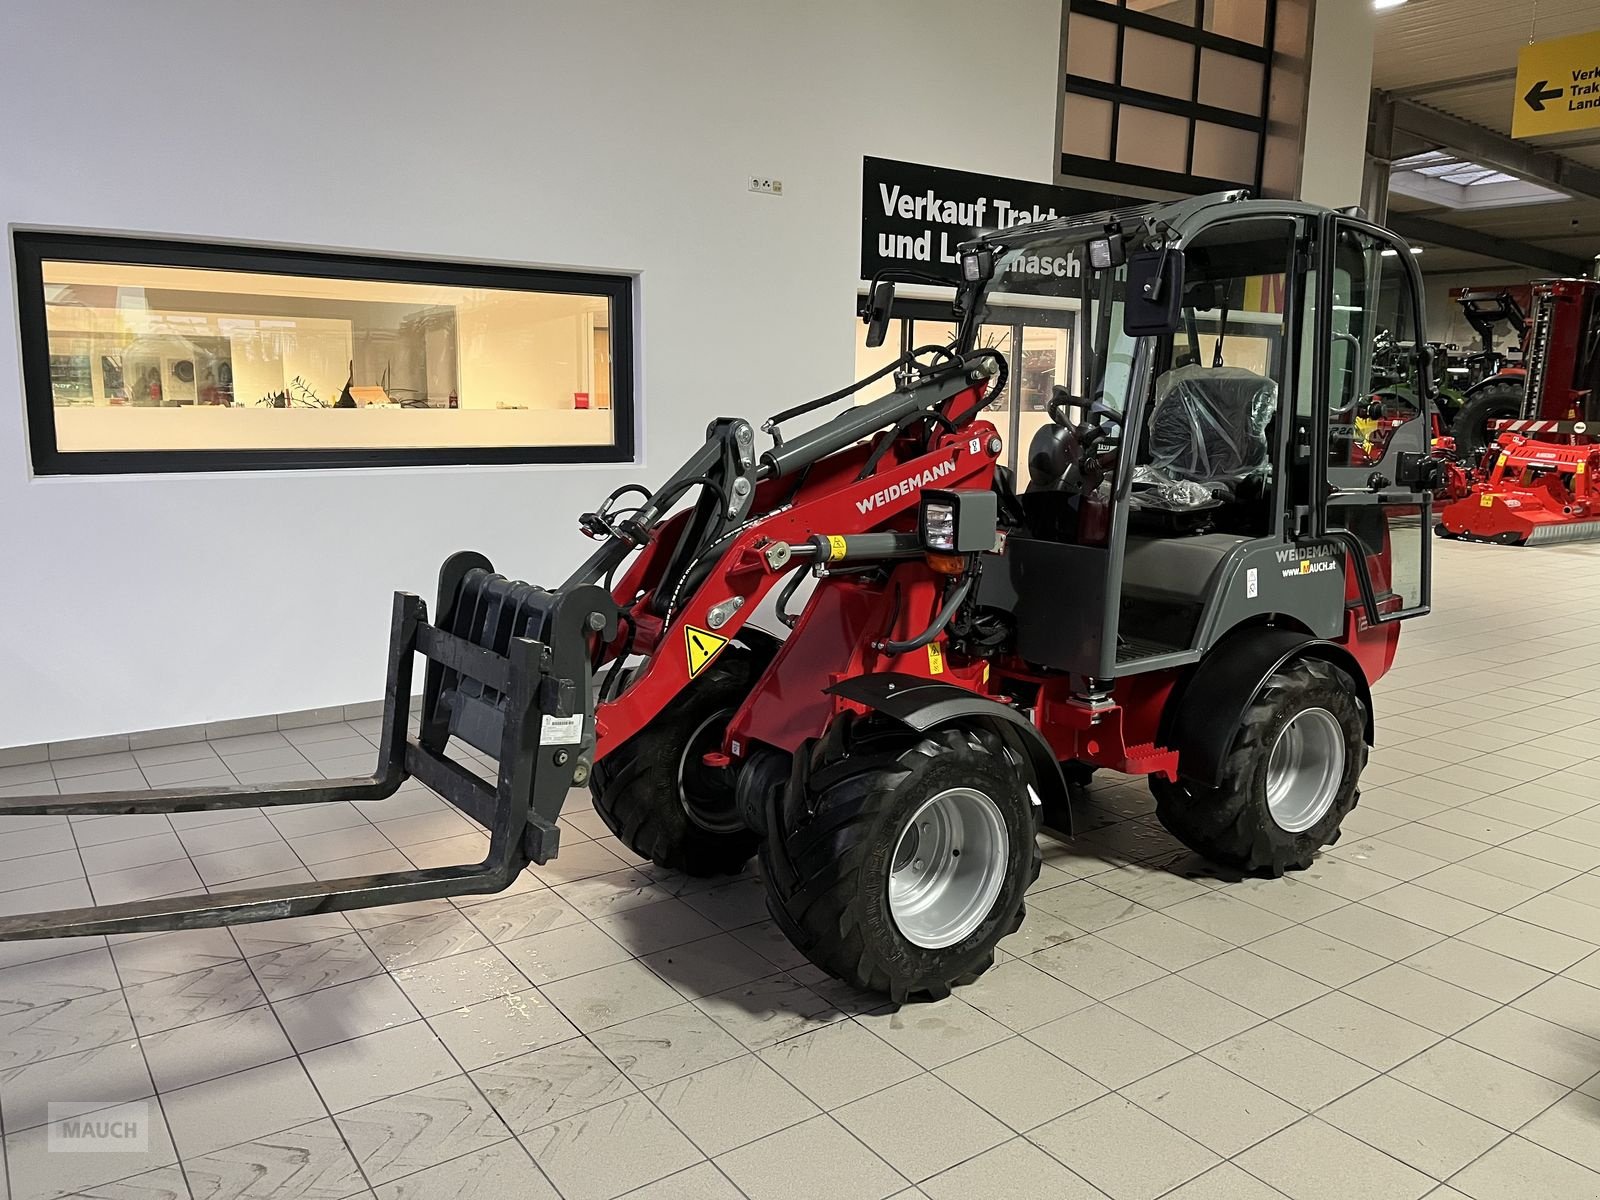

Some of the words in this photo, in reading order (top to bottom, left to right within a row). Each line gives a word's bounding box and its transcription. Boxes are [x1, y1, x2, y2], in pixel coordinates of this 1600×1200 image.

[879, 182, 986, 228] Verkauf
[878, 229, 931, 264] und
[855, 459, 956, 514] WEIDEMANN
[1275, 542, 1346, 563] WEIDEMANN
[1282, 560, 1337, 578] www.MAUCH.at
